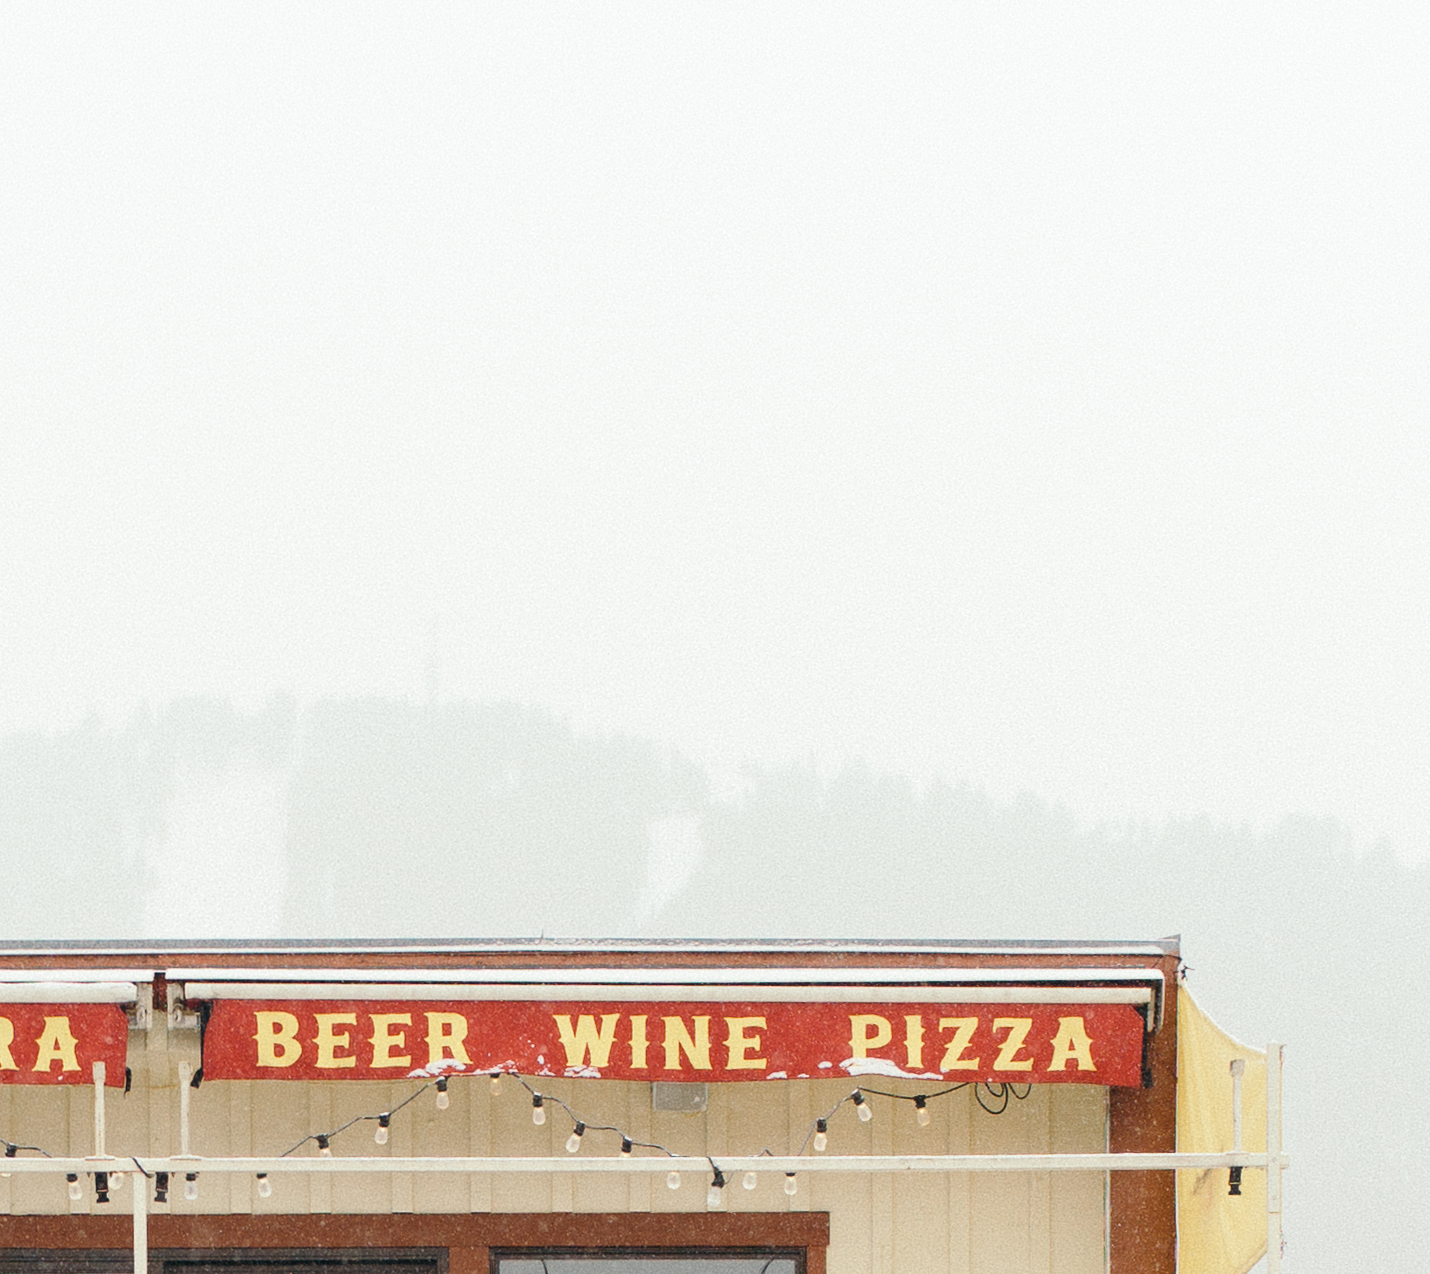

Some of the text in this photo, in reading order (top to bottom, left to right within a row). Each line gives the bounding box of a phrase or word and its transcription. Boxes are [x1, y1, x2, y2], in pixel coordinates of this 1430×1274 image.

[252, 1010, 1096, 1072] BEER WINE PIZZA
